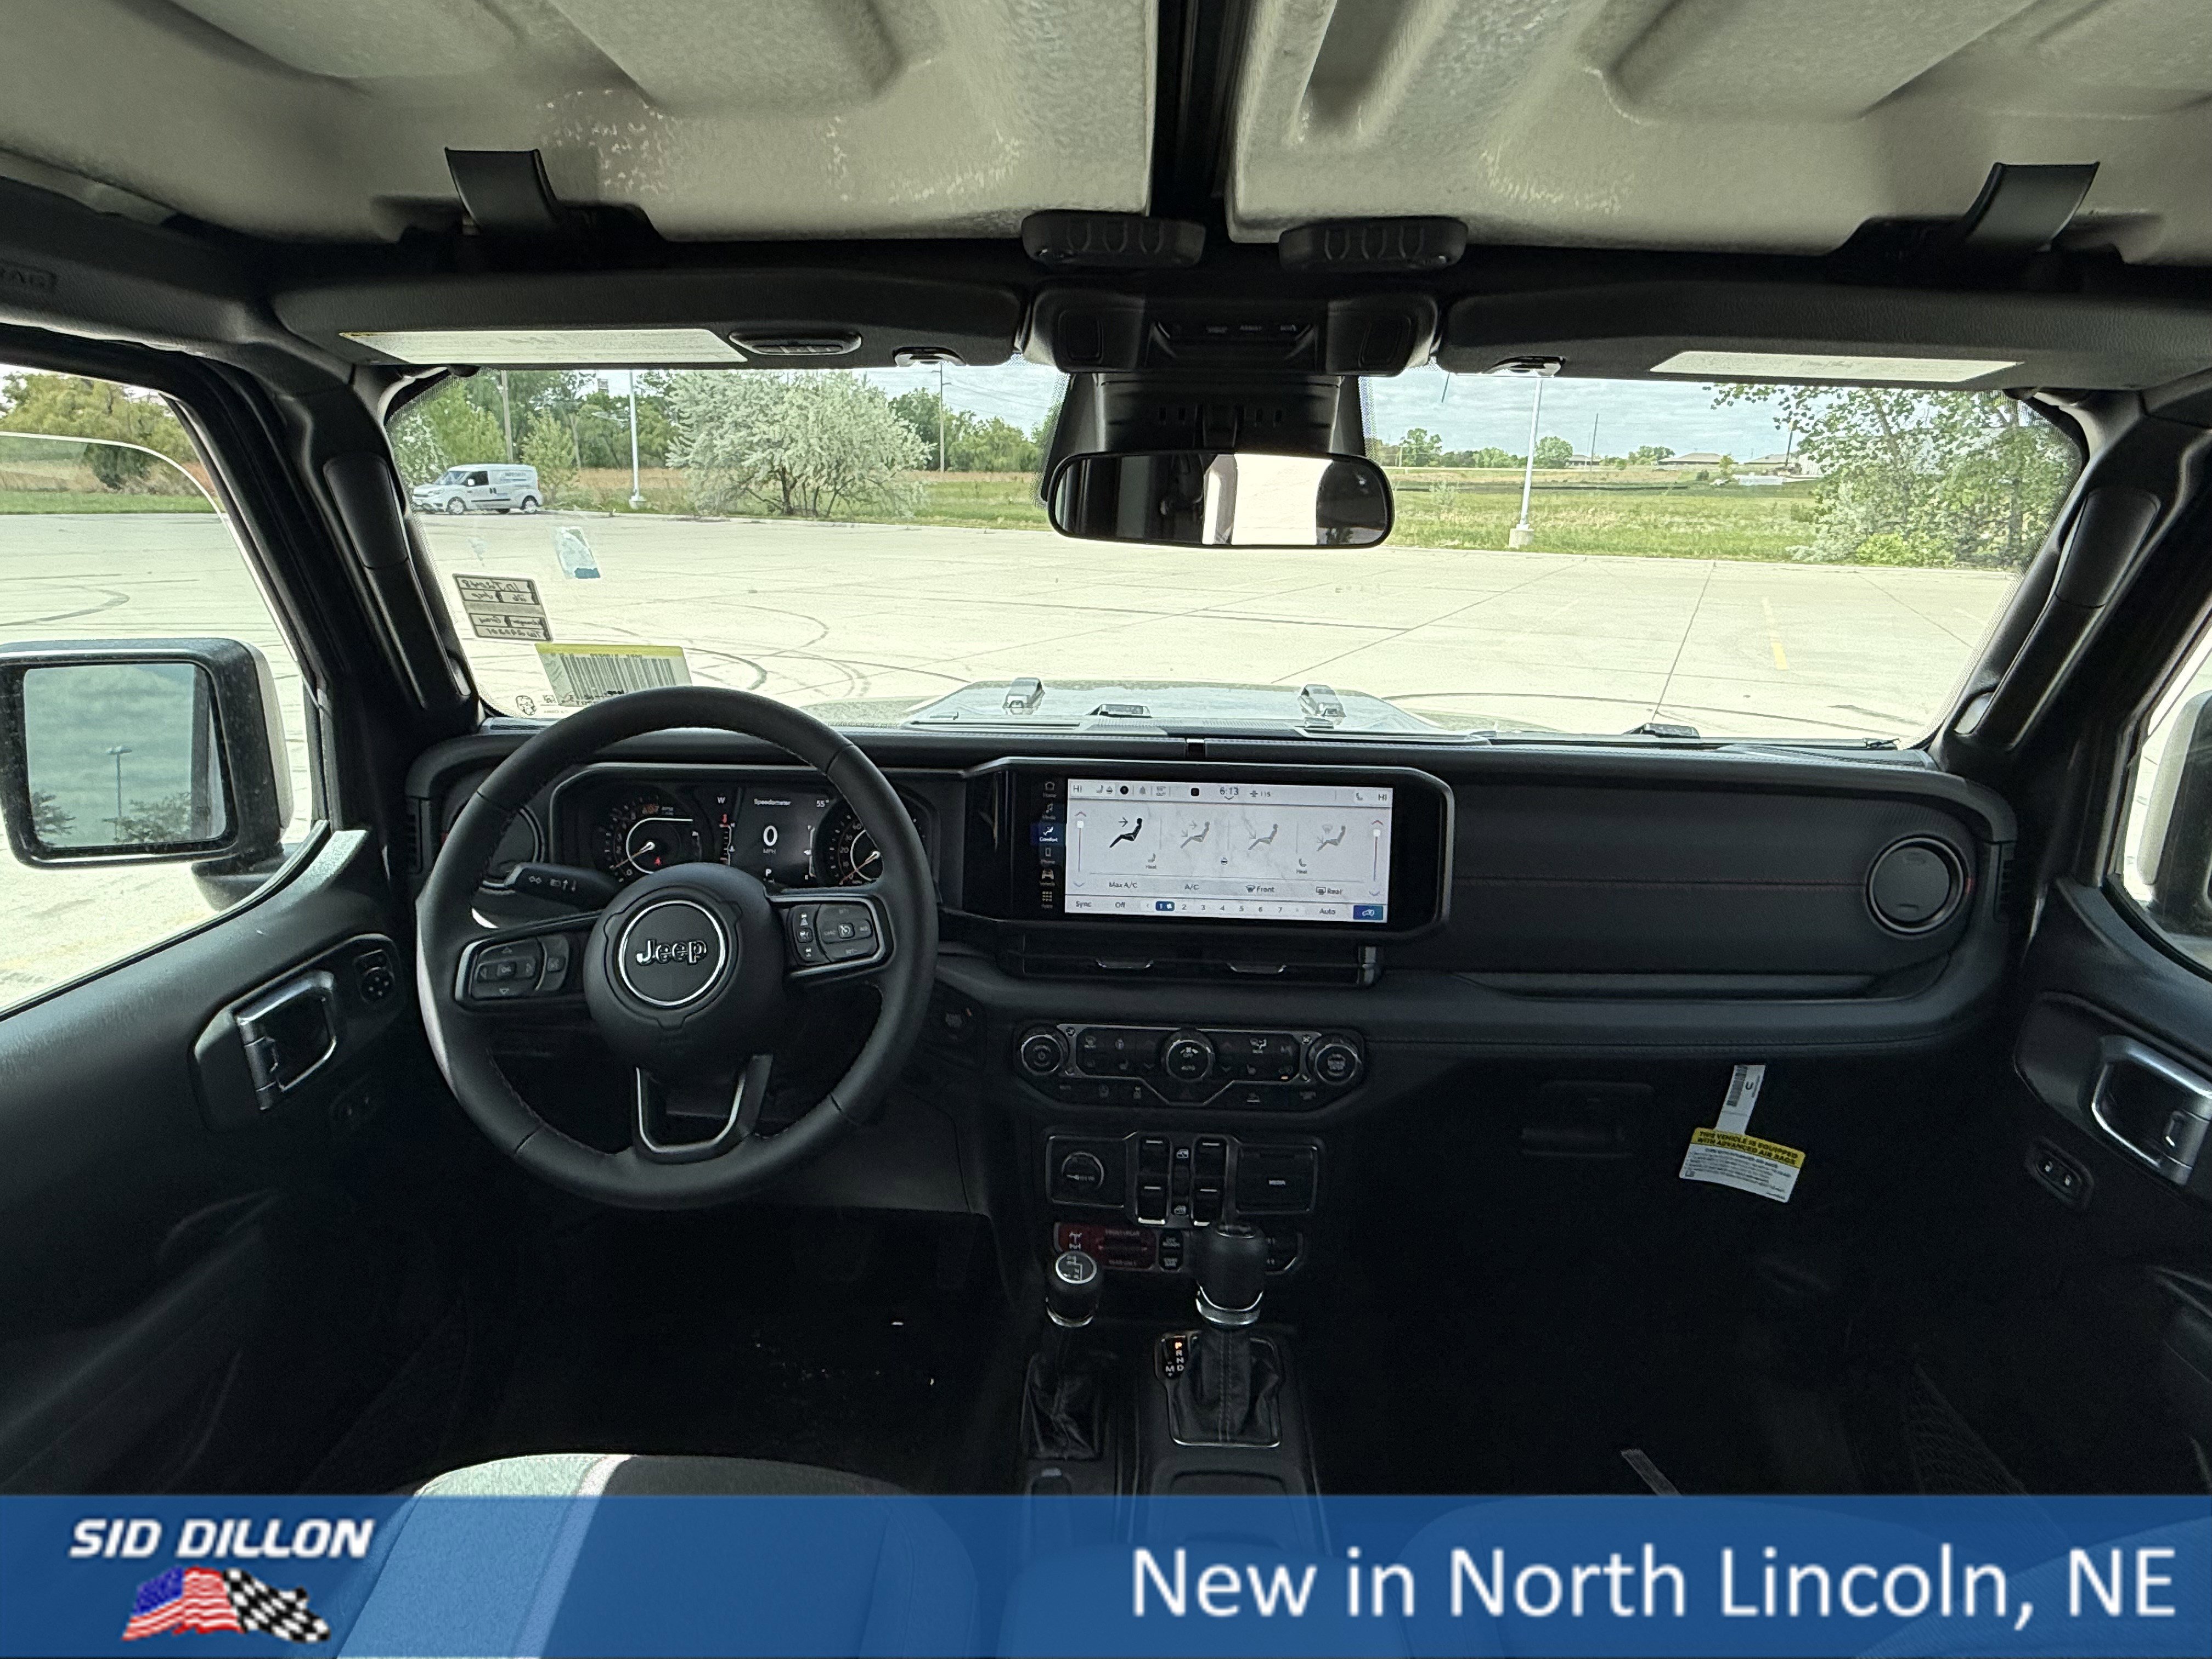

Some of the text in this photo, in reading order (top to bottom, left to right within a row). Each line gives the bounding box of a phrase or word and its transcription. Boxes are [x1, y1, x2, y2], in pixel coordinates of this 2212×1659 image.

[1073, 785, 1083, 793] HI
[1219, 787, 1239, 796] 6:13
[717, 796, 726, 804] W
[1378, 793, 1388, 802] HI
[763, 825, 778, 847] 0
[765, 868, 772, 878] P
[1075, 900, 1092, 909] Sync
[636, 939, 707, 965] Jeep
